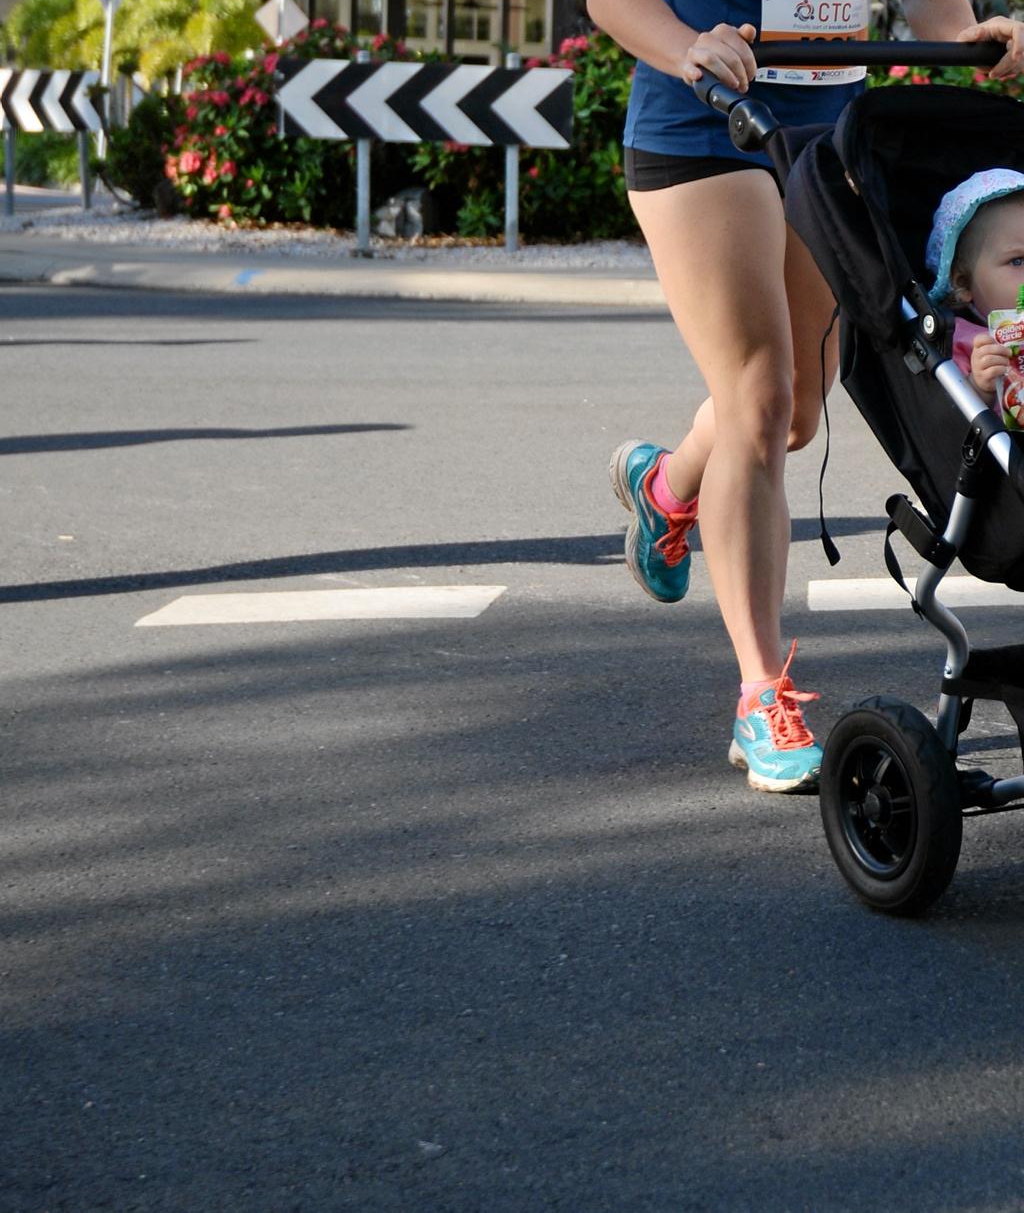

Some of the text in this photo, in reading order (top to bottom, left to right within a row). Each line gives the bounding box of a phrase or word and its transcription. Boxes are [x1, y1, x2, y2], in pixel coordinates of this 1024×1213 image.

[818, 2, 852, 22] CTC
[997, 324, 1024, 338] golden
[1001, 331, 1023, 341] circle
